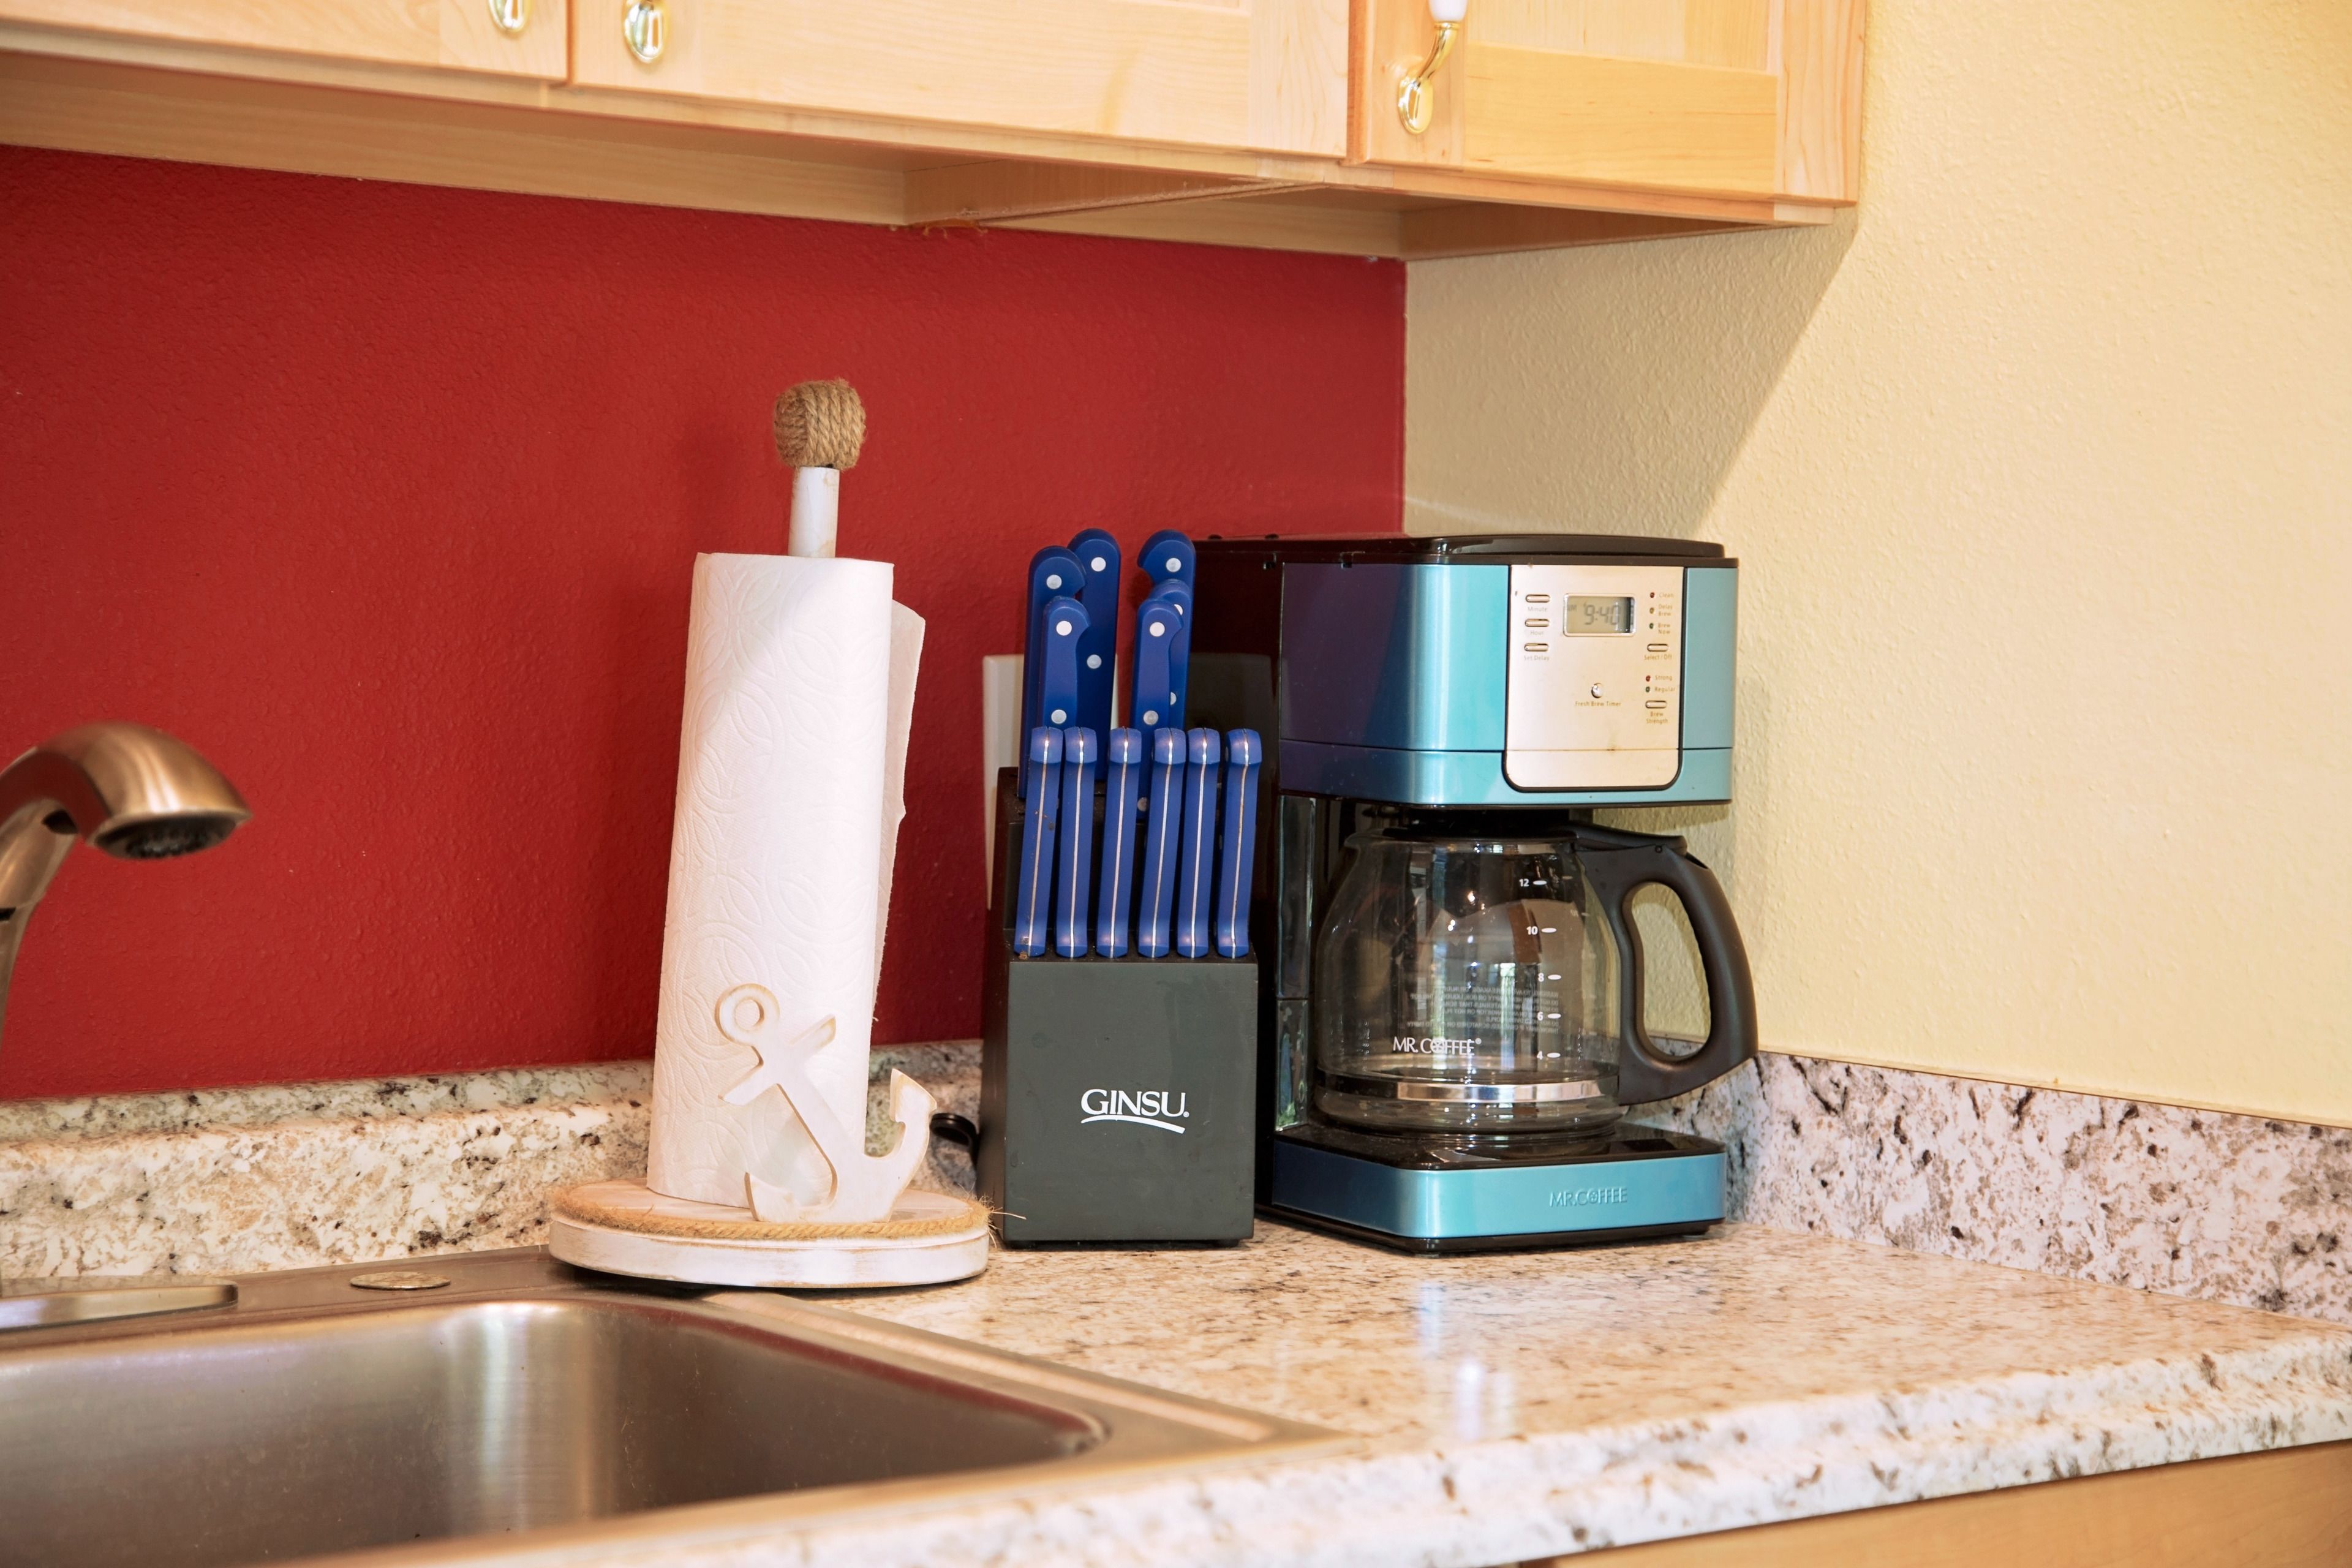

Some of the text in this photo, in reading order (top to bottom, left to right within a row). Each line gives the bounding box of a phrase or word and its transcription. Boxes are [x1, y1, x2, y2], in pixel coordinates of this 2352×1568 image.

[1519, 878, 1529, 887] 12
[1526, 926, 1538, 935] 10
[1538, 973, 1544, 982] 8
[1537, 1011, 1544, 1021] 6
[1420, 1038, 1475, 1056] COFFEE
[1536, 1050, 1543, 1060] 4
[1080, 1088, 1186, 1118] GINSU
